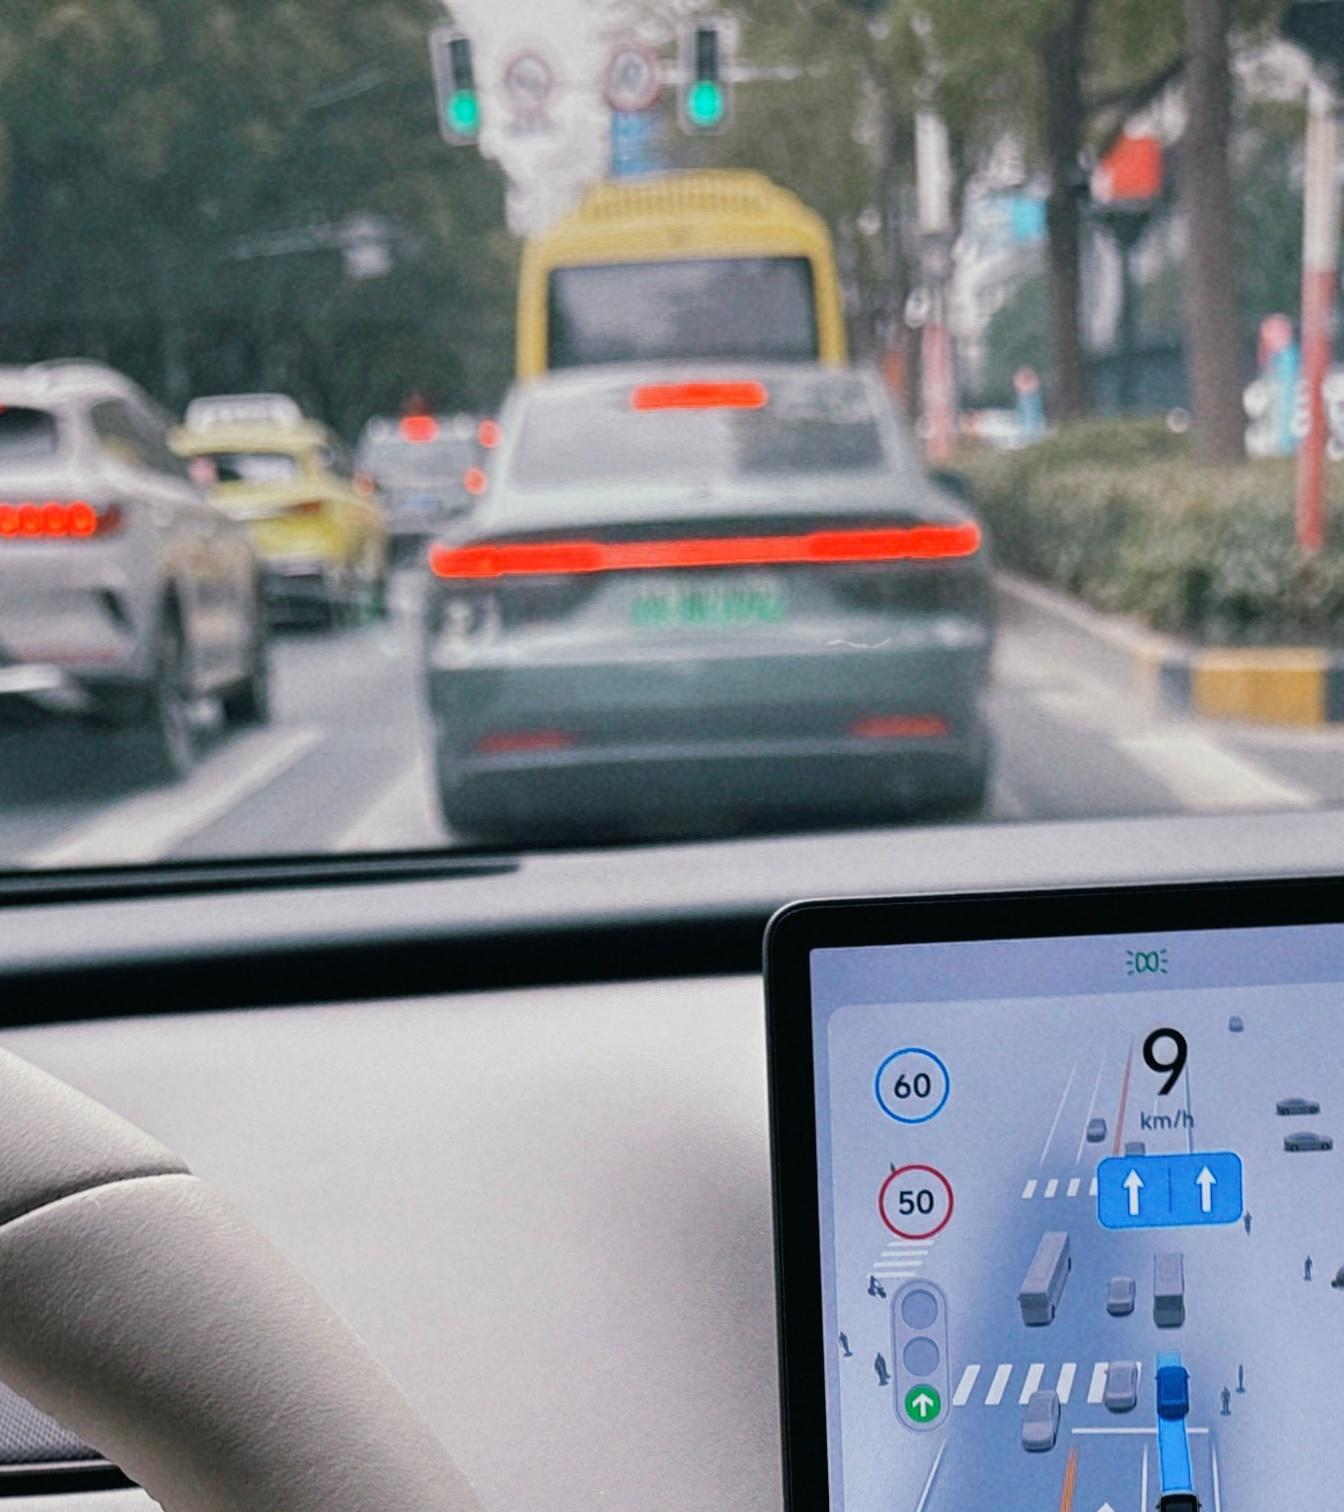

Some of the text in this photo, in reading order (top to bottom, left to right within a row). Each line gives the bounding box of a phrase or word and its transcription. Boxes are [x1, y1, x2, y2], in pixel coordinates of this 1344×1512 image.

[1141, 1027, 1189, 1096] 9
[893, 1072, 933, 1100] 60
[1140, 1109, 1196, 1132] km/h
[897, 1188, 934, 1216] 50
